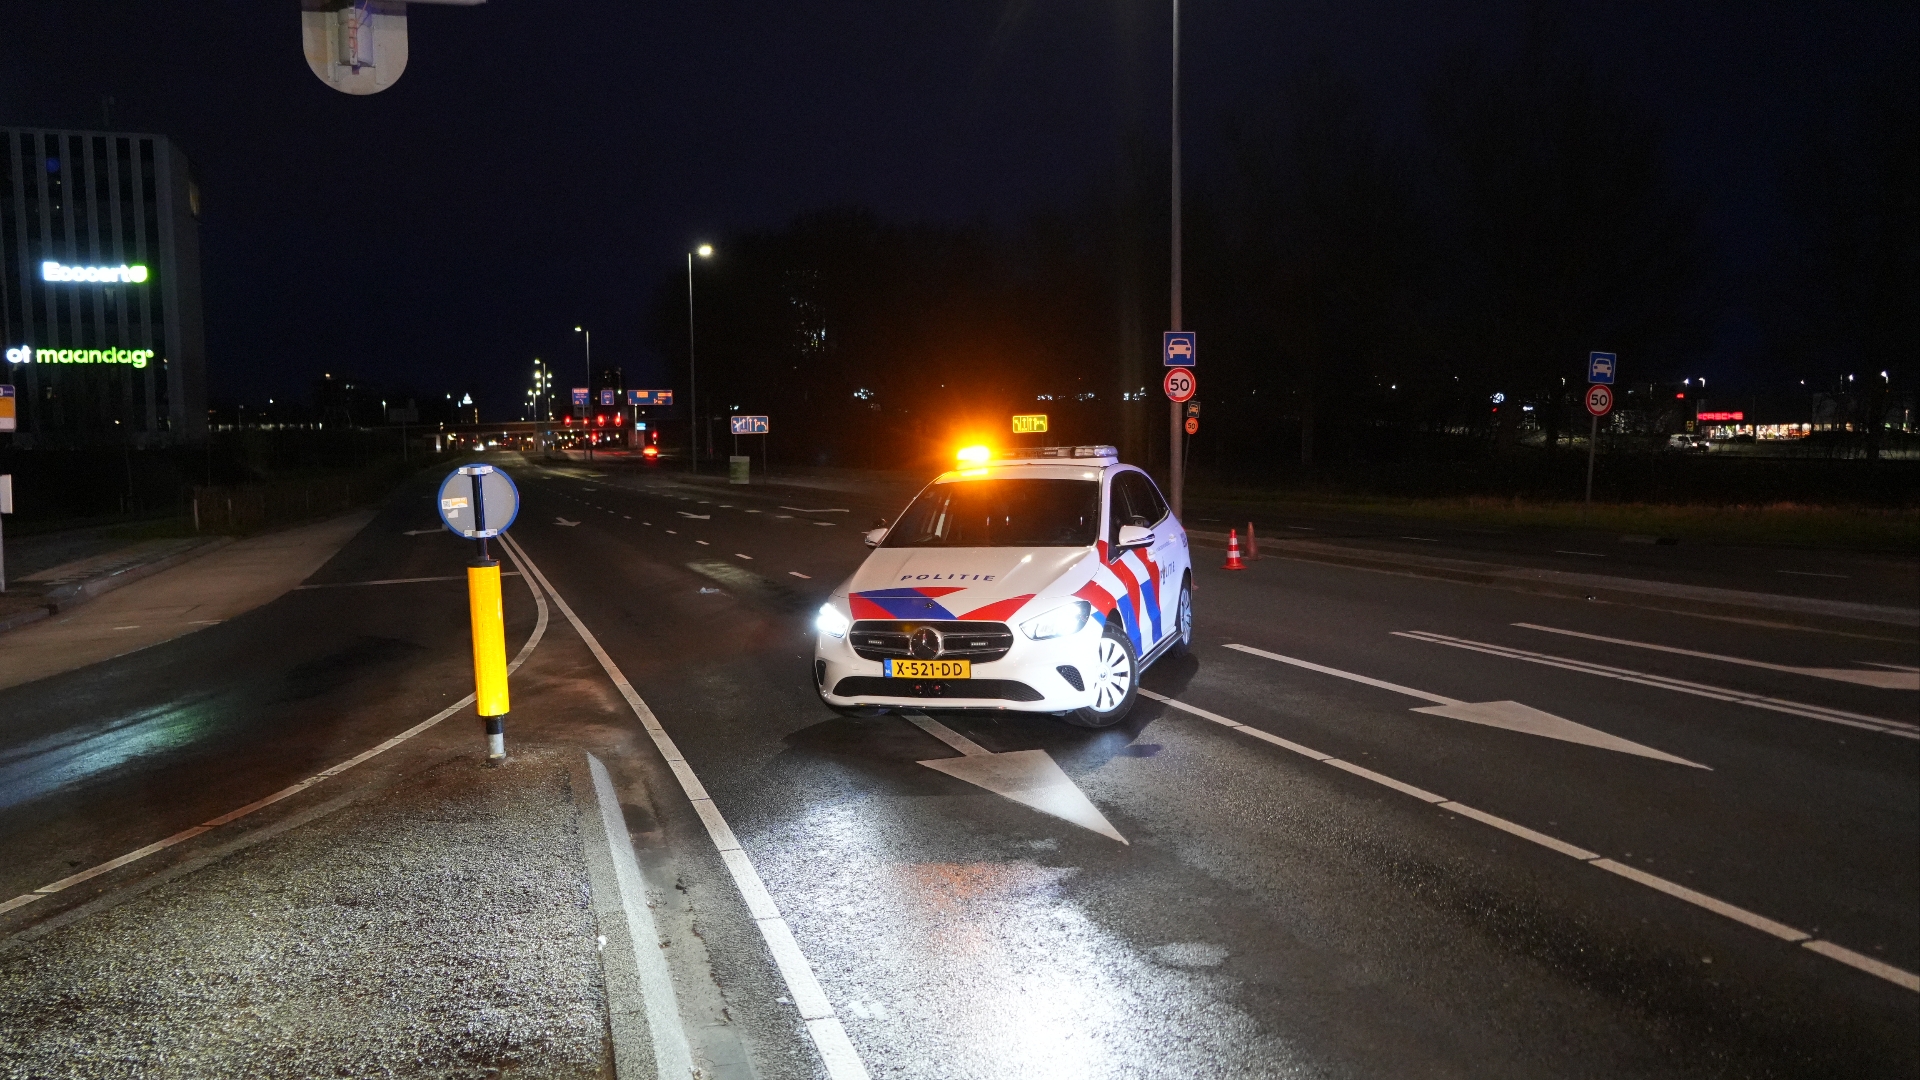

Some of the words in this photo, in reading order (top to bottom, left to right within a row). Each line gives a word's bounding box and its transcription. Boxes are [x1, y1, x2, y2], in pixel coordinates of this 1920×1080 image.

[36, 347, 147, 368] maandag
[1170, 379, 1190, 391] 50
[1590, 394, 1608, 406] 50
[1187, 422, 1196, 430] 50
[901, 573, 995, 581] POLITIE
[896, 662, 963, 676] X-521-DD
